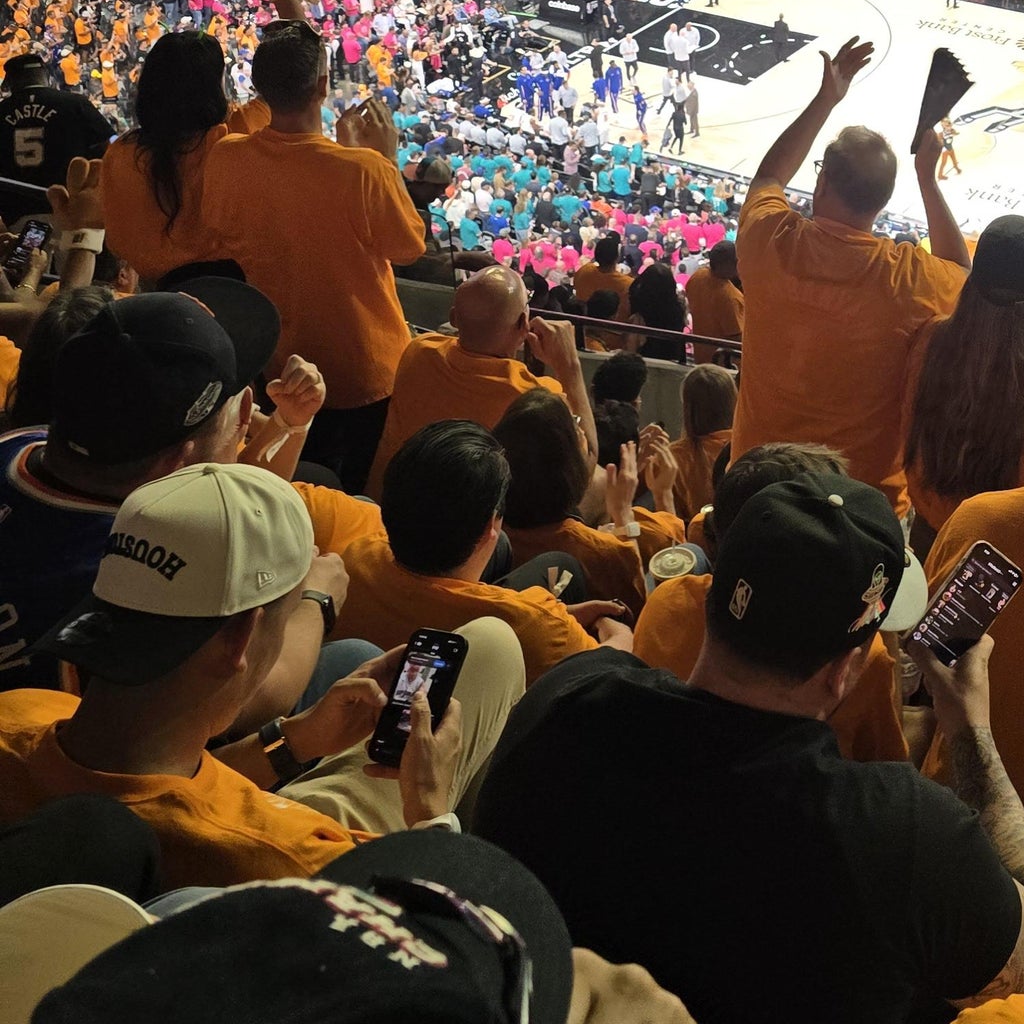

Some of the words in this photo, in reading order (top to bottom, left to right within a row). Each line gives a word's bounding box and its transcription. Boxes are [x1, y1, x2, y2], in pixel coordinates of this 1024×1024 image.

[915, 19, 962, 35] Bank
[964, 29, 1011, 45] Frost
[5, 104, 57, 126] CASTLE
[14, 127, 45, 167] 5
[964, 187, 1021, 211] Bank
